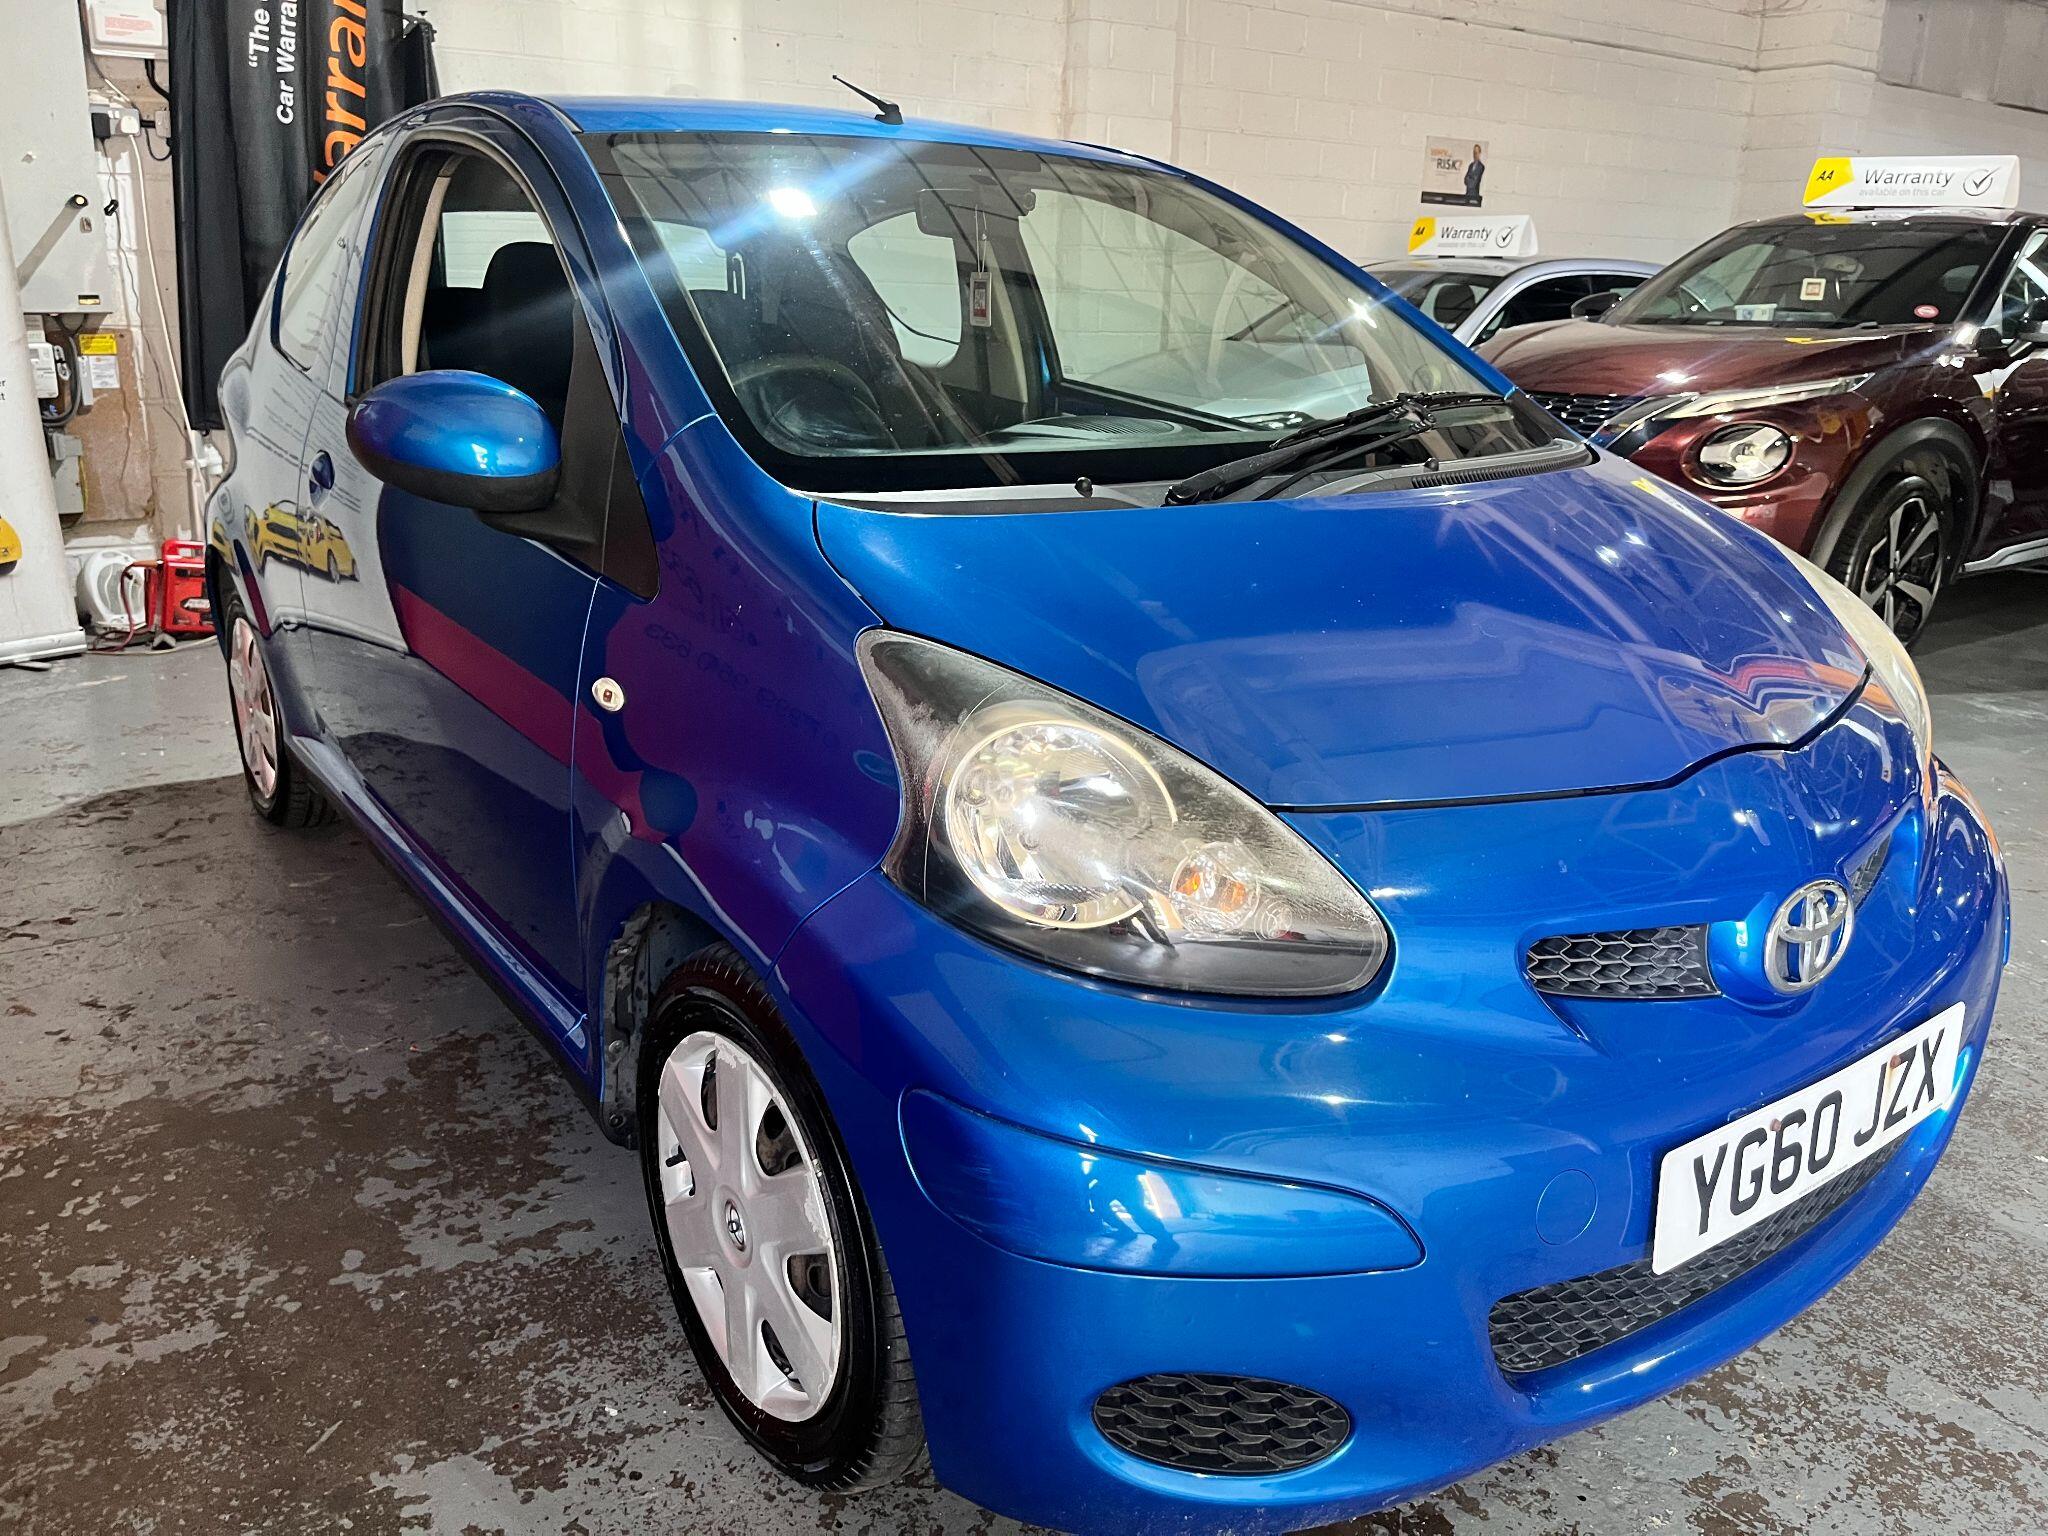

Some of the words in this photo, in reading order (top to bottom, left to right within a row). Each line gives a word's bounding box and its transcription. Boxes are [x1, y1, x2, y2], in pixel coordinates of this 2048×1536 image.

[276, 0, 298, 73] Warra
[277, 80, 295, 125] Car
[313, 0, 367, 185] arra
[1816, 169, 1836, 182] AA
[1865, 168, 1956, 188] Warranty
[1859, 187, 1897, 197] available
[1898, 189, 1911, 197] on
[1912, 187, 1930, 197] this
[1930, 189, 1947, 197] car
[1441, 226, 1494, 242] Warranty
[1693, 1089, 1843, 1237] YG60
[1854, 1027, 1946, 1148] JZX
